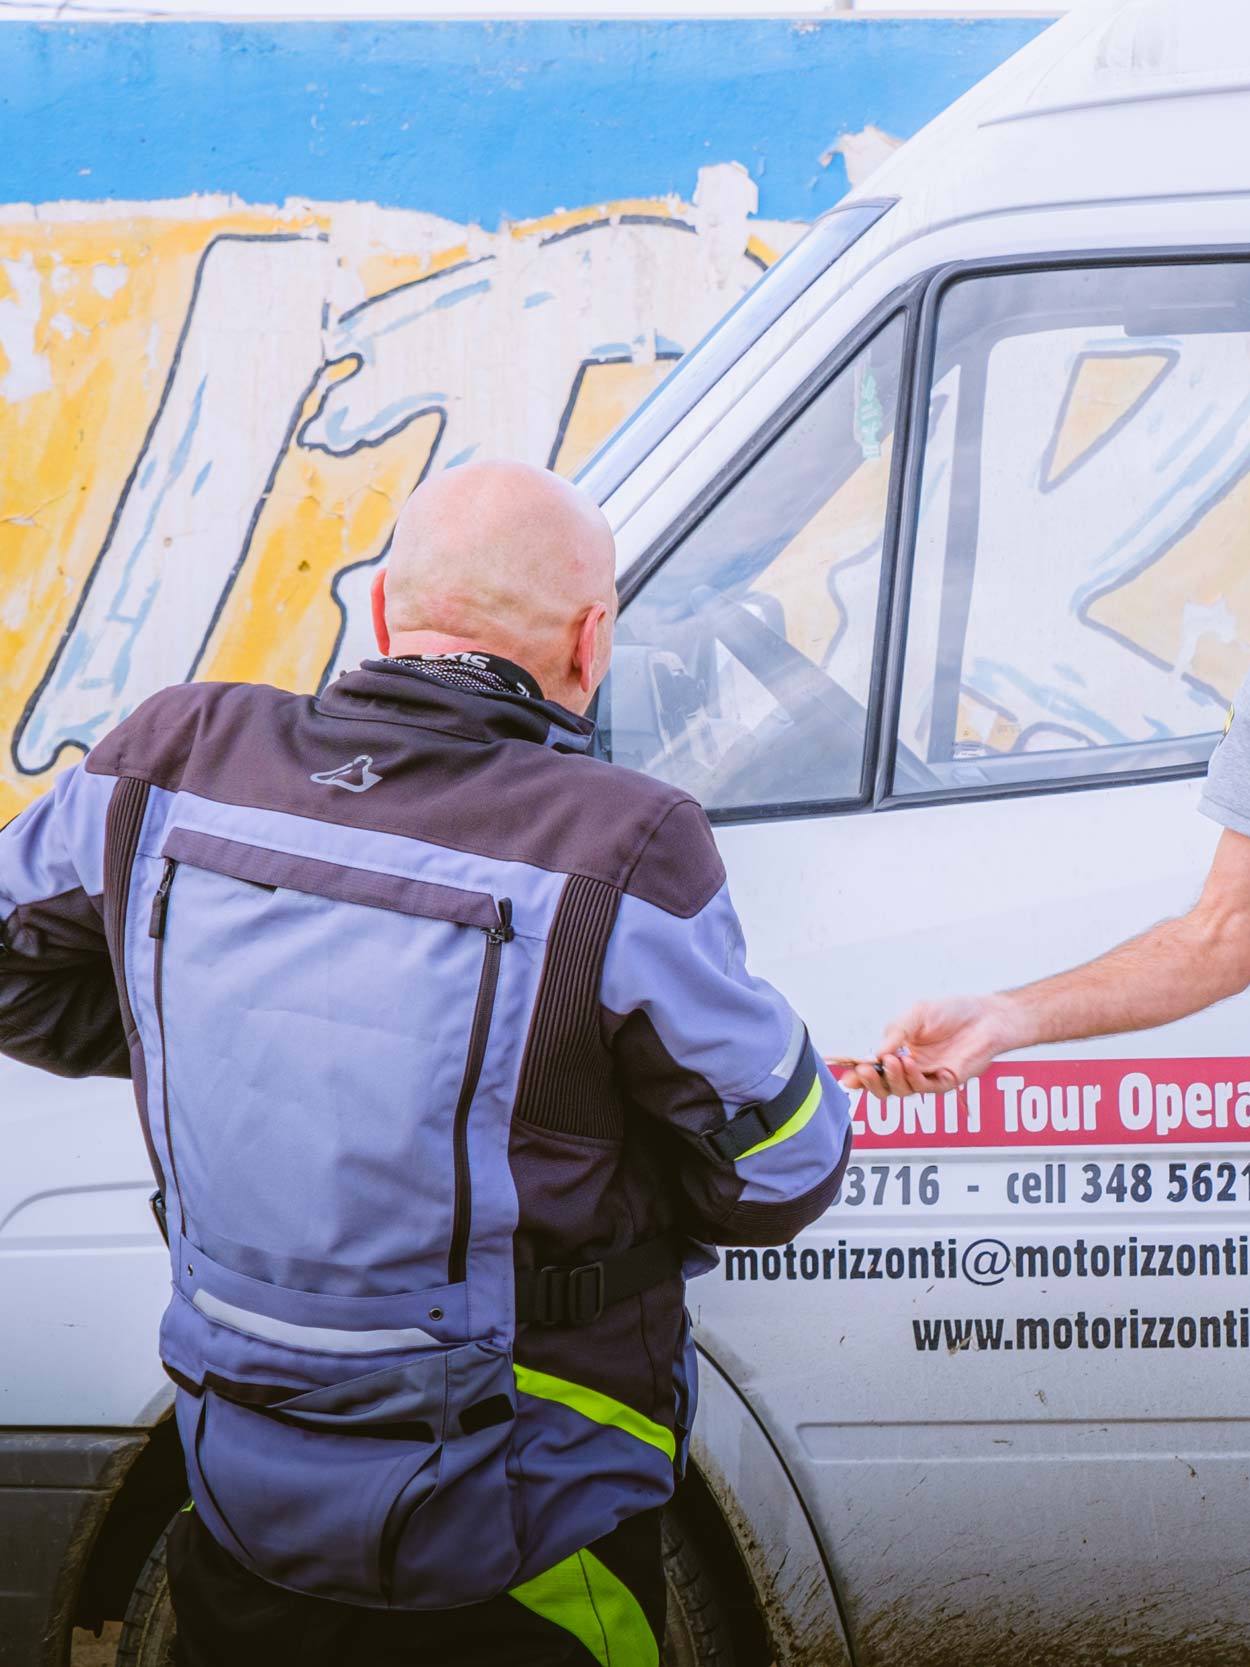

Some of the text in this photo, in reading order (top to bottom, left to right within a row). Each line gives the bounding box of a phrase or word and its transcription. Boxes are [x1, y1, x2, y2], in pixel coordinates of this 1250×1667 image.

[996, 1075, 1101, 1133] Tour
[832, 1165, 940, 1207] 3716
[1006, 1163, 1066, 1204] cell
[1081, 1163, 1153, 1203] 348
